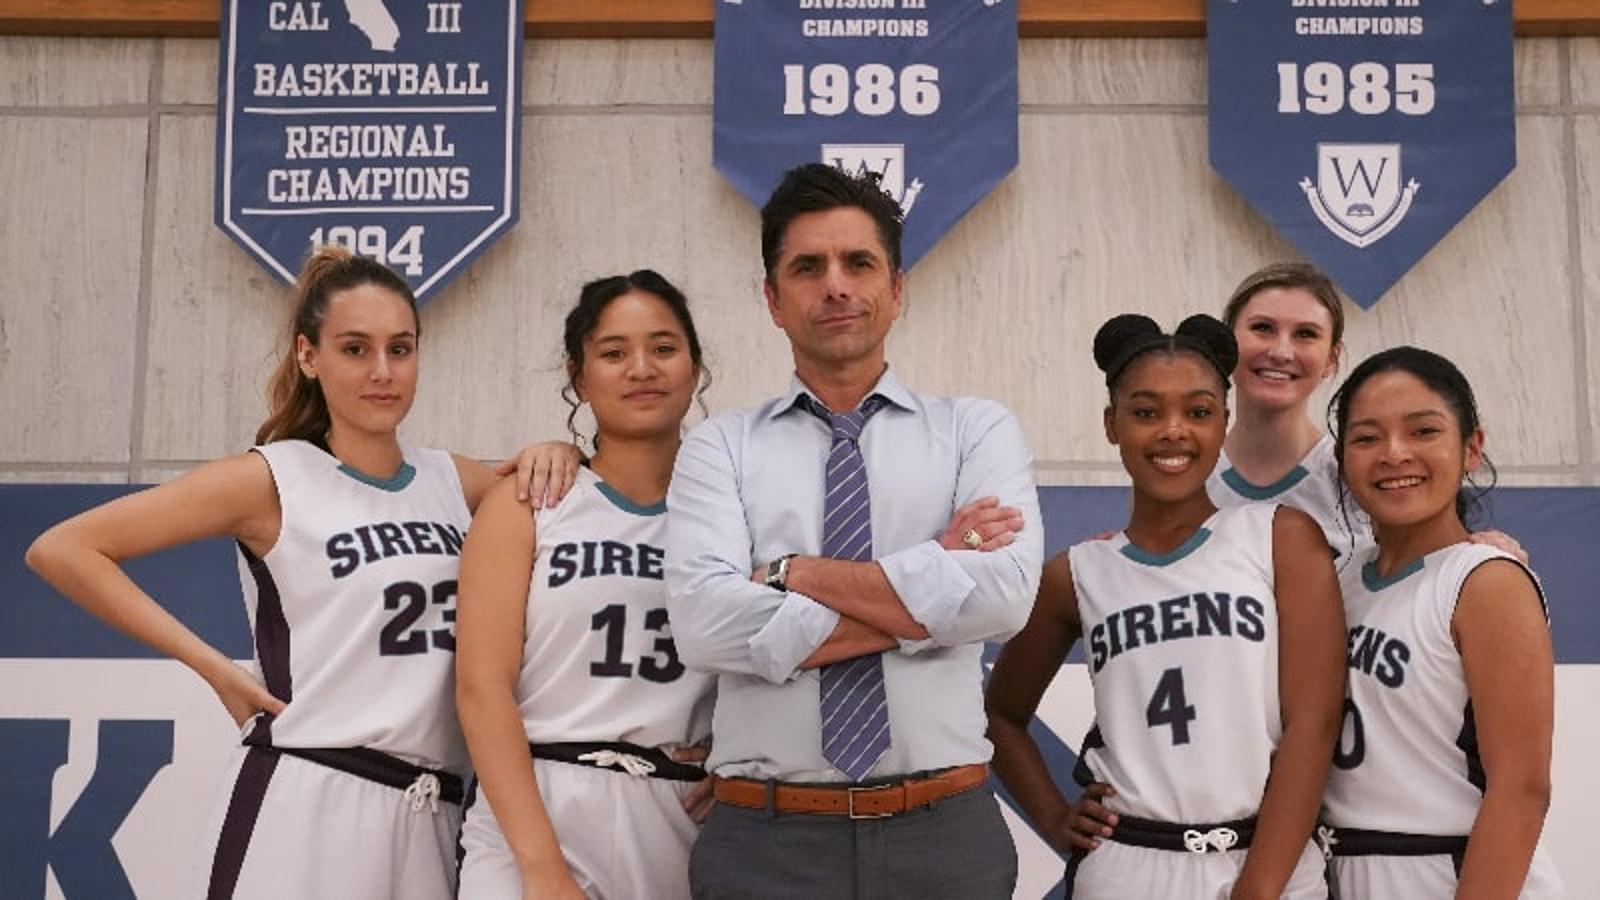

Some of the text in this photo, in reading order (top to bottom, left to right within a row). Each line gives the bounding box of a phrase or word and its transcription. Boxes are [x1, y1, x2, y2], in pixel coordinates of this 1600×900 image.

[269, 1, 329, 31] CAL
[426, 3, 462, 33] III
[802, 19, 929, 37] CHAMPIONS
[1295, 16, 1423, 35] CHAMPIONS
[253, 62, 489, 97] BASKETBALL
[783, 63, 941, 116] 1986
[1277, 61, 1435, 115] 1985
[285, 124, 455, 160] REGIONAL
[267, 167, 470, 203] CHAMPIONS
[1330, 157, 1388, 200] W
[326, 521, 467, 579] SIREN
[548, 541, 665, 588] SIRE
[589, 604, 686, 683] 13
[1090, 592, 1265, 673] SIRENS
[1145, 667, 1197, 746] 4
